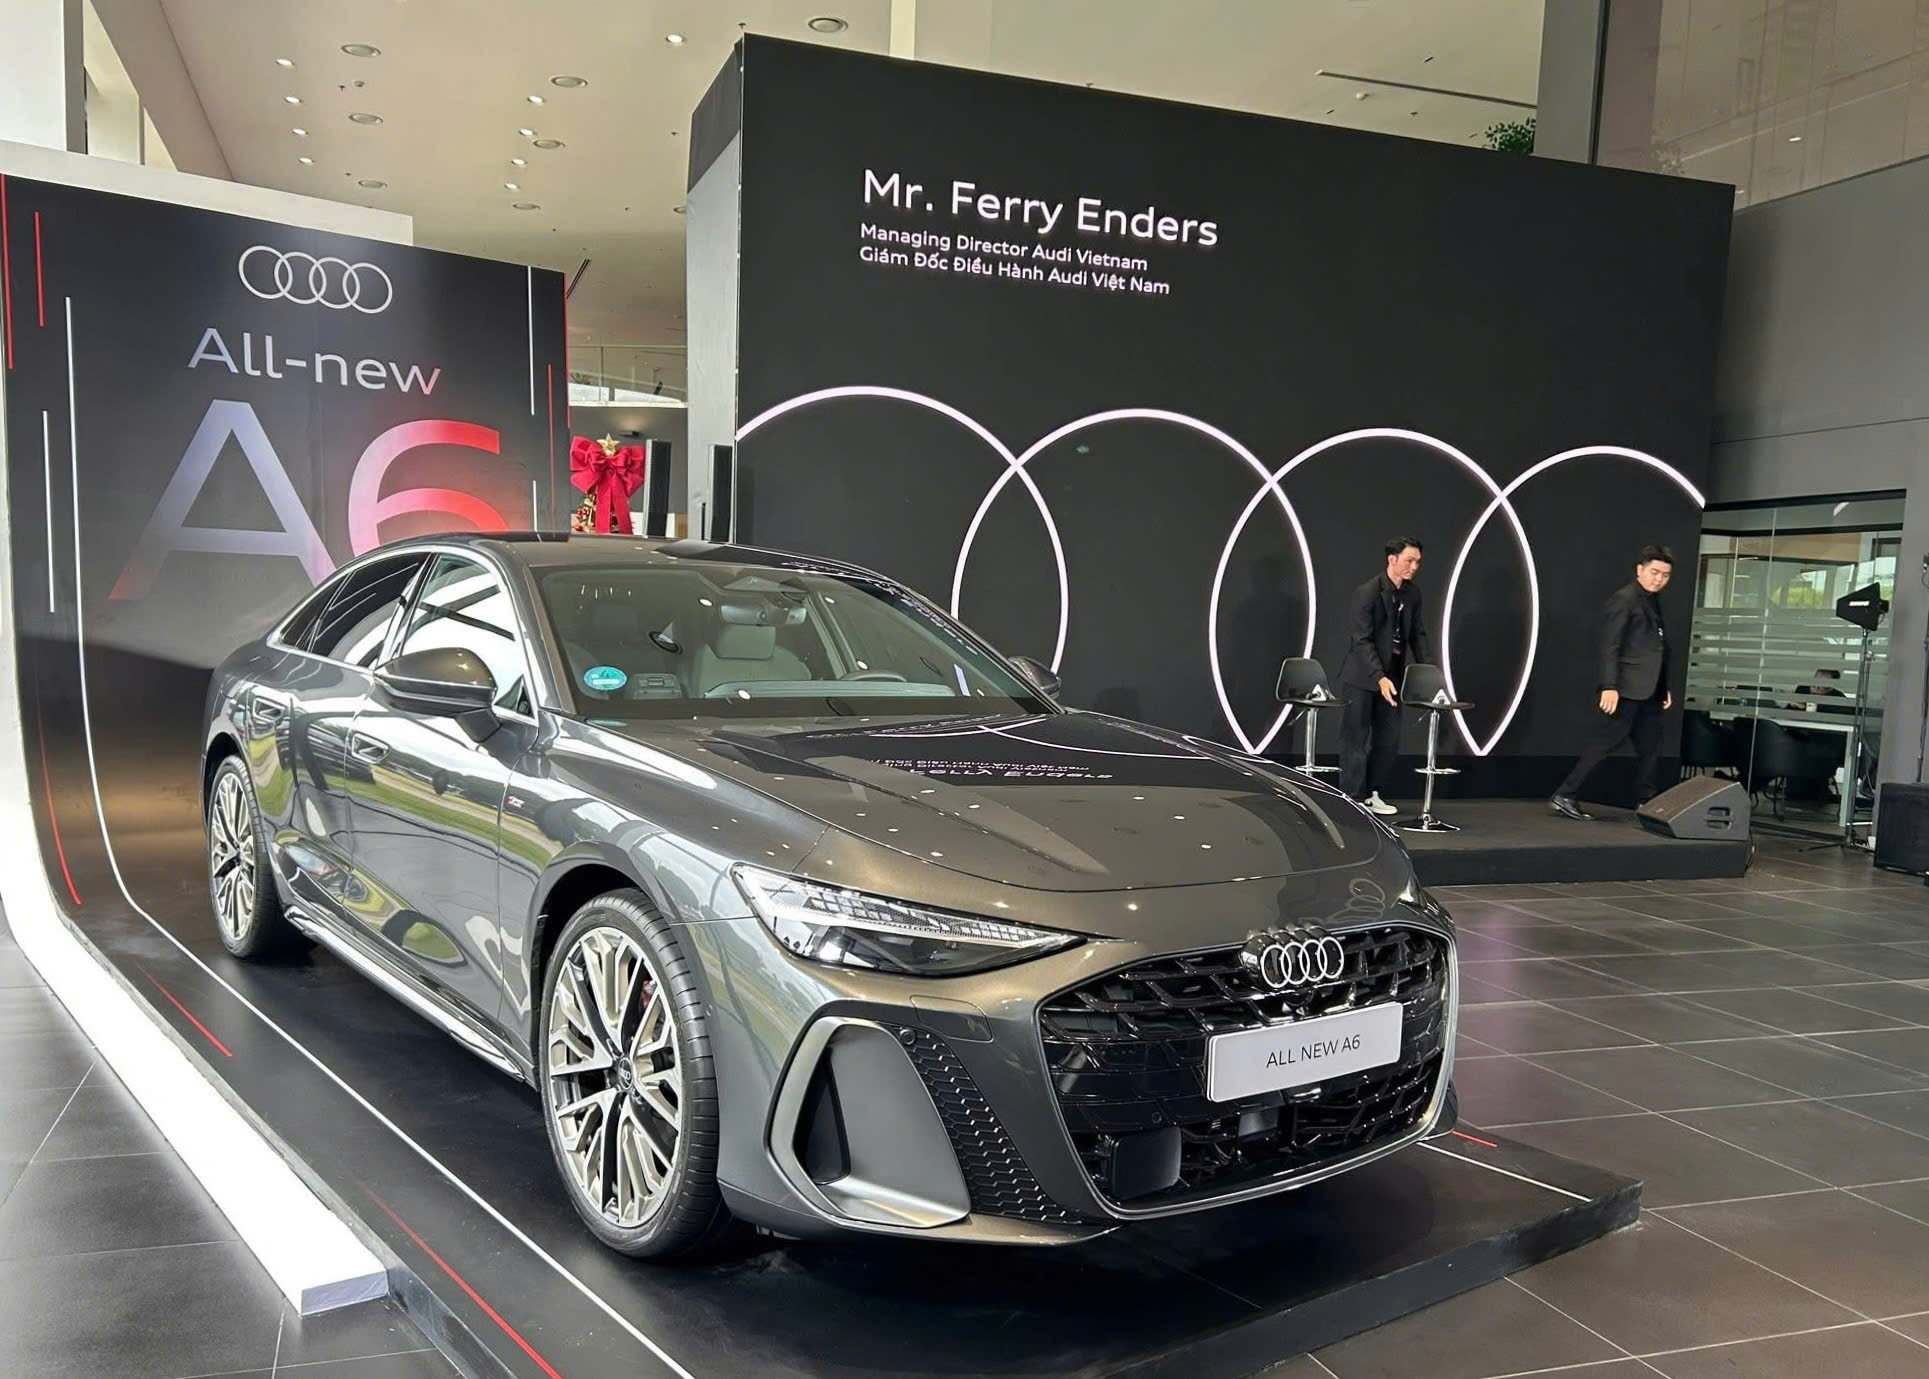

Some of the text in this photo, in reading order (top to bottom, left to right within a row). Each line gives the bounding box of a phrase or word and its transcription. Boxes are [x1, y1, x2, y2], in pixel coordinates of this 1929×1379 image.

[864, 169, 1218, 246] Mr. Ferry Enders
[859, 246, 908, 266] Giám
[913, 251, 949, 271] Đốc
[998, 261, 1044, 281] Hành
[1047, 267, 1088, 286] Audi
[1091, 271, 1126, 292] Việt
[1130, 276, 1170, 295] Nam
[860, 222, 1148, 271] Managing Director Audi Vietnam
[187, 327, 442, 396] All-new
[107, 399, 508, 600] A6
[1266, 1034, 1361, 1068] ALL NEW A6
